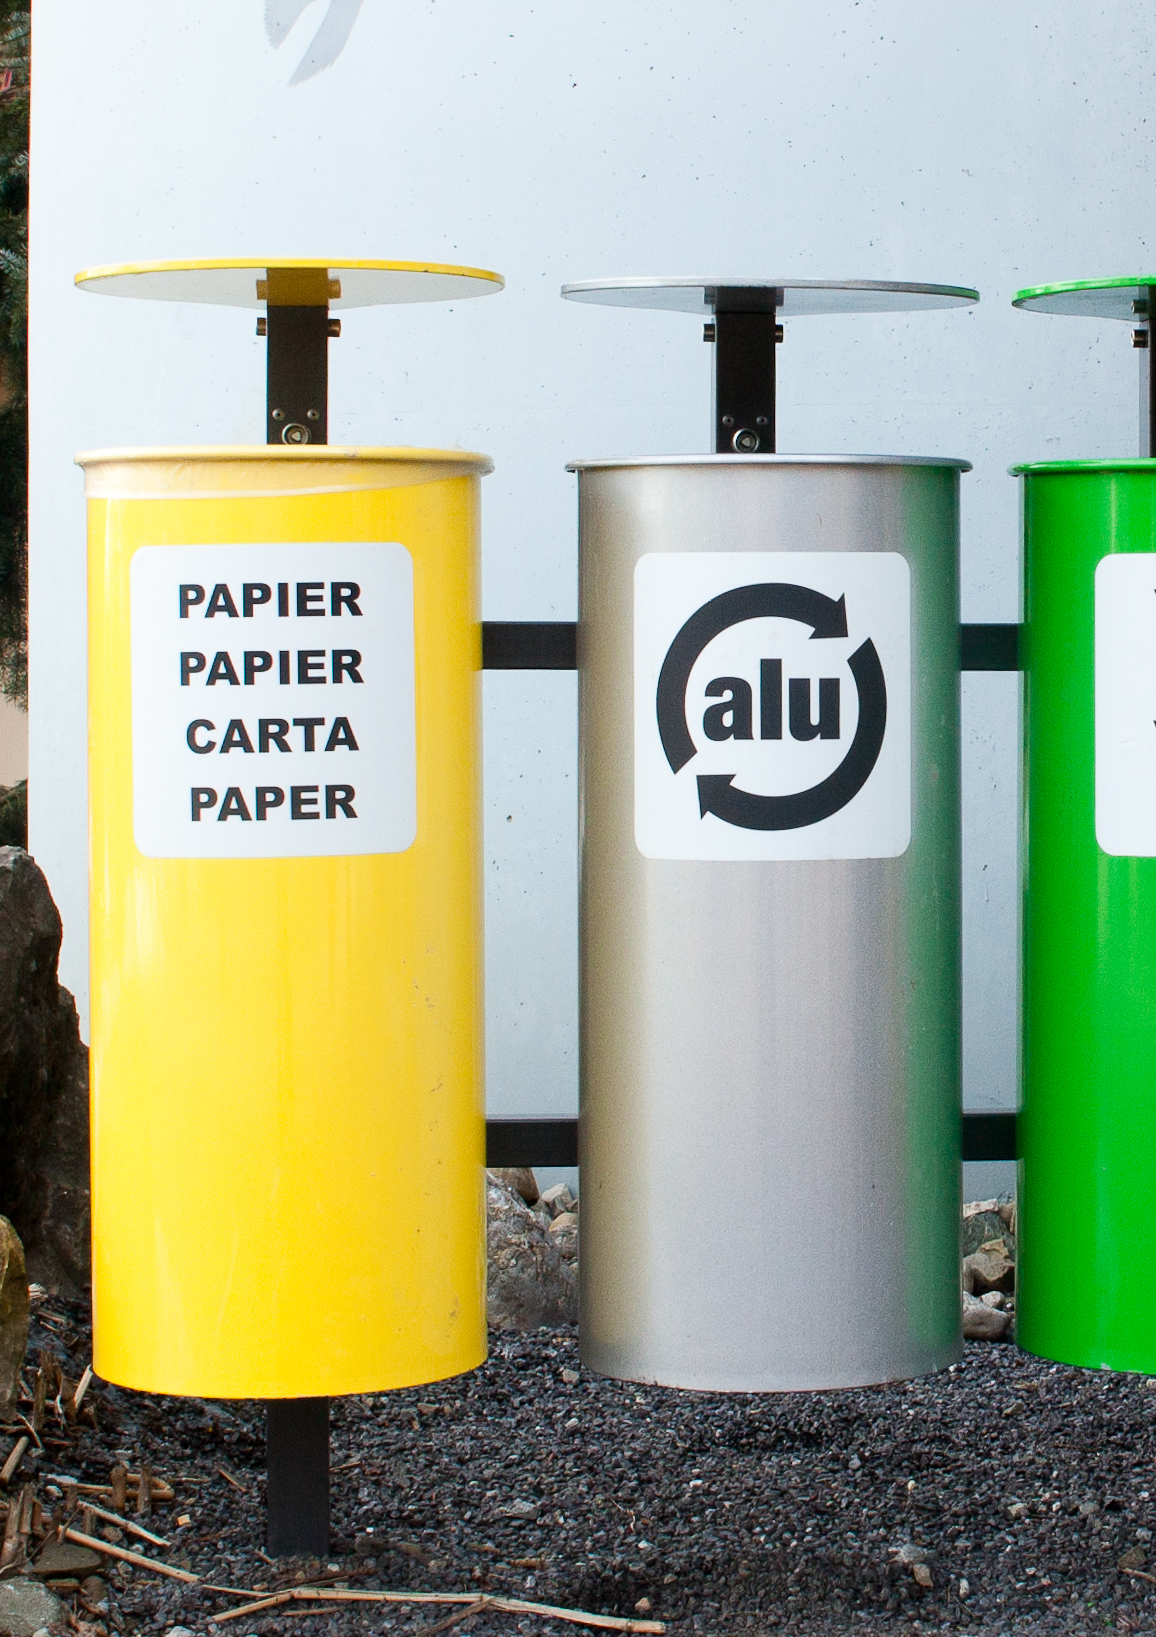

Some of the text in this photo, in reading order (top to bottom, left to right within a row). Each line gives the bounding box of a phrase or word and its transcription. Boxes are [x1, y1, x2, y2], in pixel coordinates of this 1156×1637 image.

[180, 582, 362, 618] PAPIER
[181, 650, 363, 685] PAPIER
[703, 658, 840, 741] alu
[186, 717, 359, 754] CARTA
[192, 785, 357, 821] PAPER
